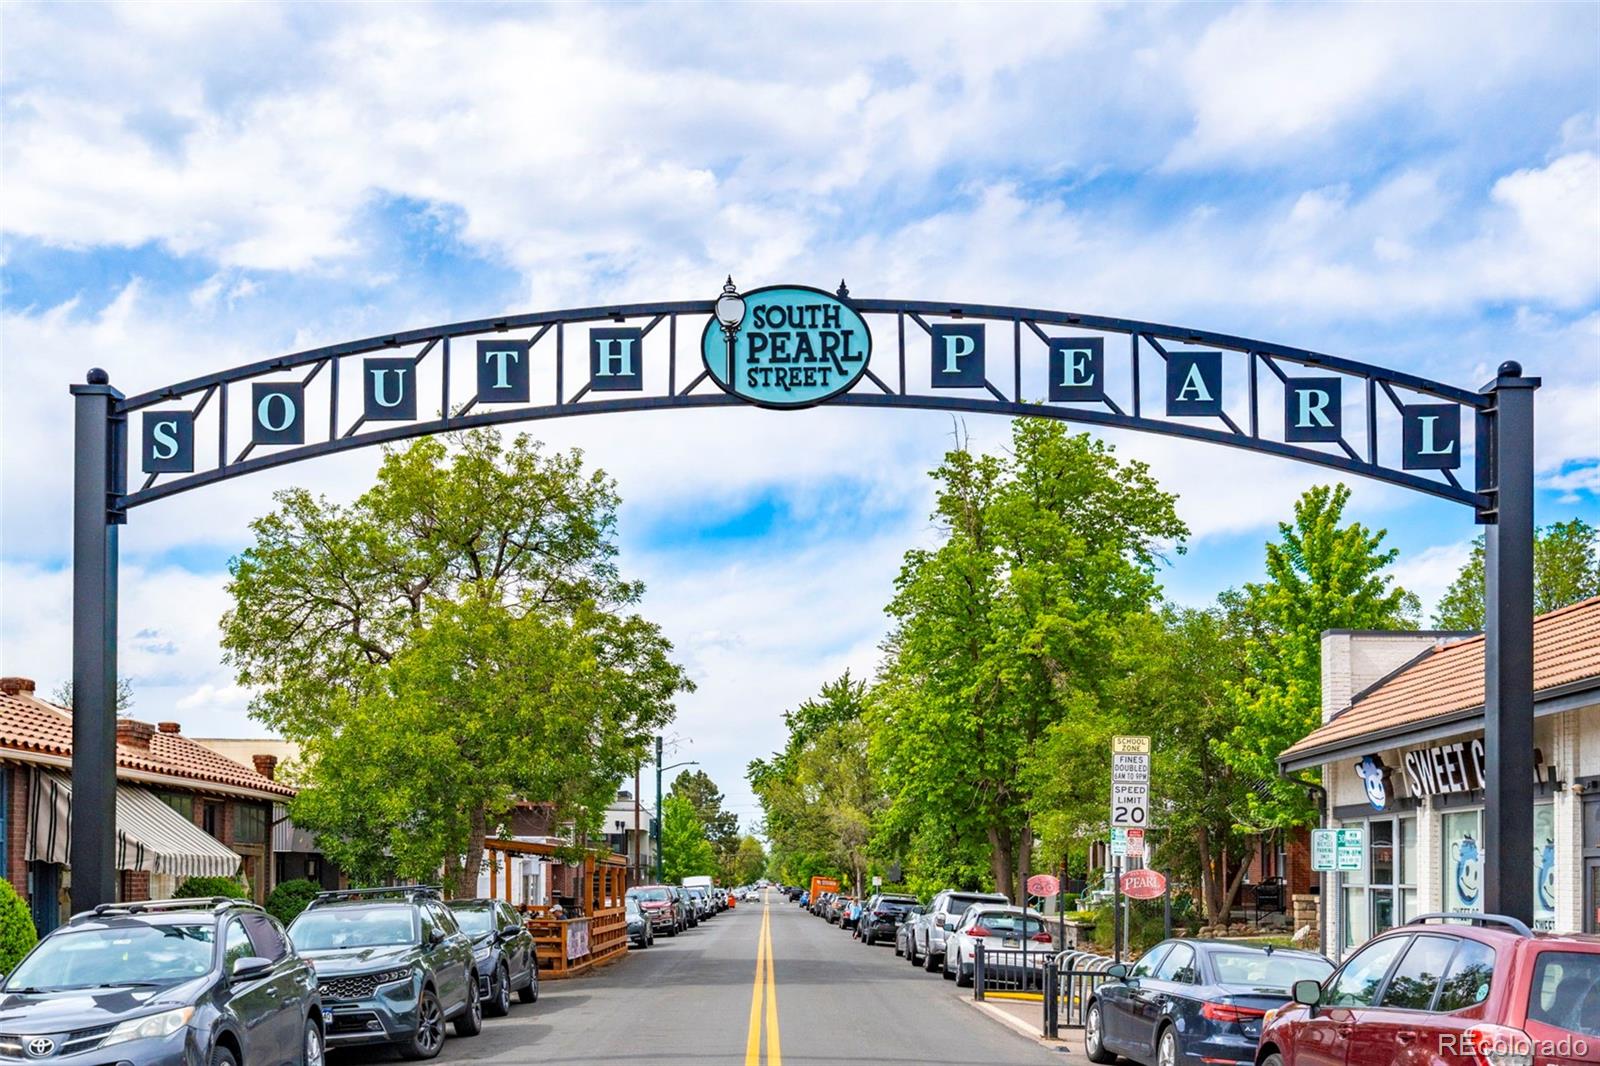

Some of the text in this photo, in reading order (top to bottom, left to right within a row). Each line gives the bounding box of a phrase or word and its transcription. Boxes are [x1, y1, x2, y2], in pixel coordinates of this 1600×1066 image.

[753, 304, 841, 329] SOUTH
[746, 330, 863, 375] PEARL
[747, 366, 832, 391] STREET
[1114, 764, 1147, 772] DOUBLED
[1405, 743, 1469, 797] SWEET
[1114, 786, 1146, 794] SPEED
[1117, 796, 1142, 804] LIMIT
[1115, 806, 1145, 823] 20
[1124, 877, 1160, 890] PEARL
